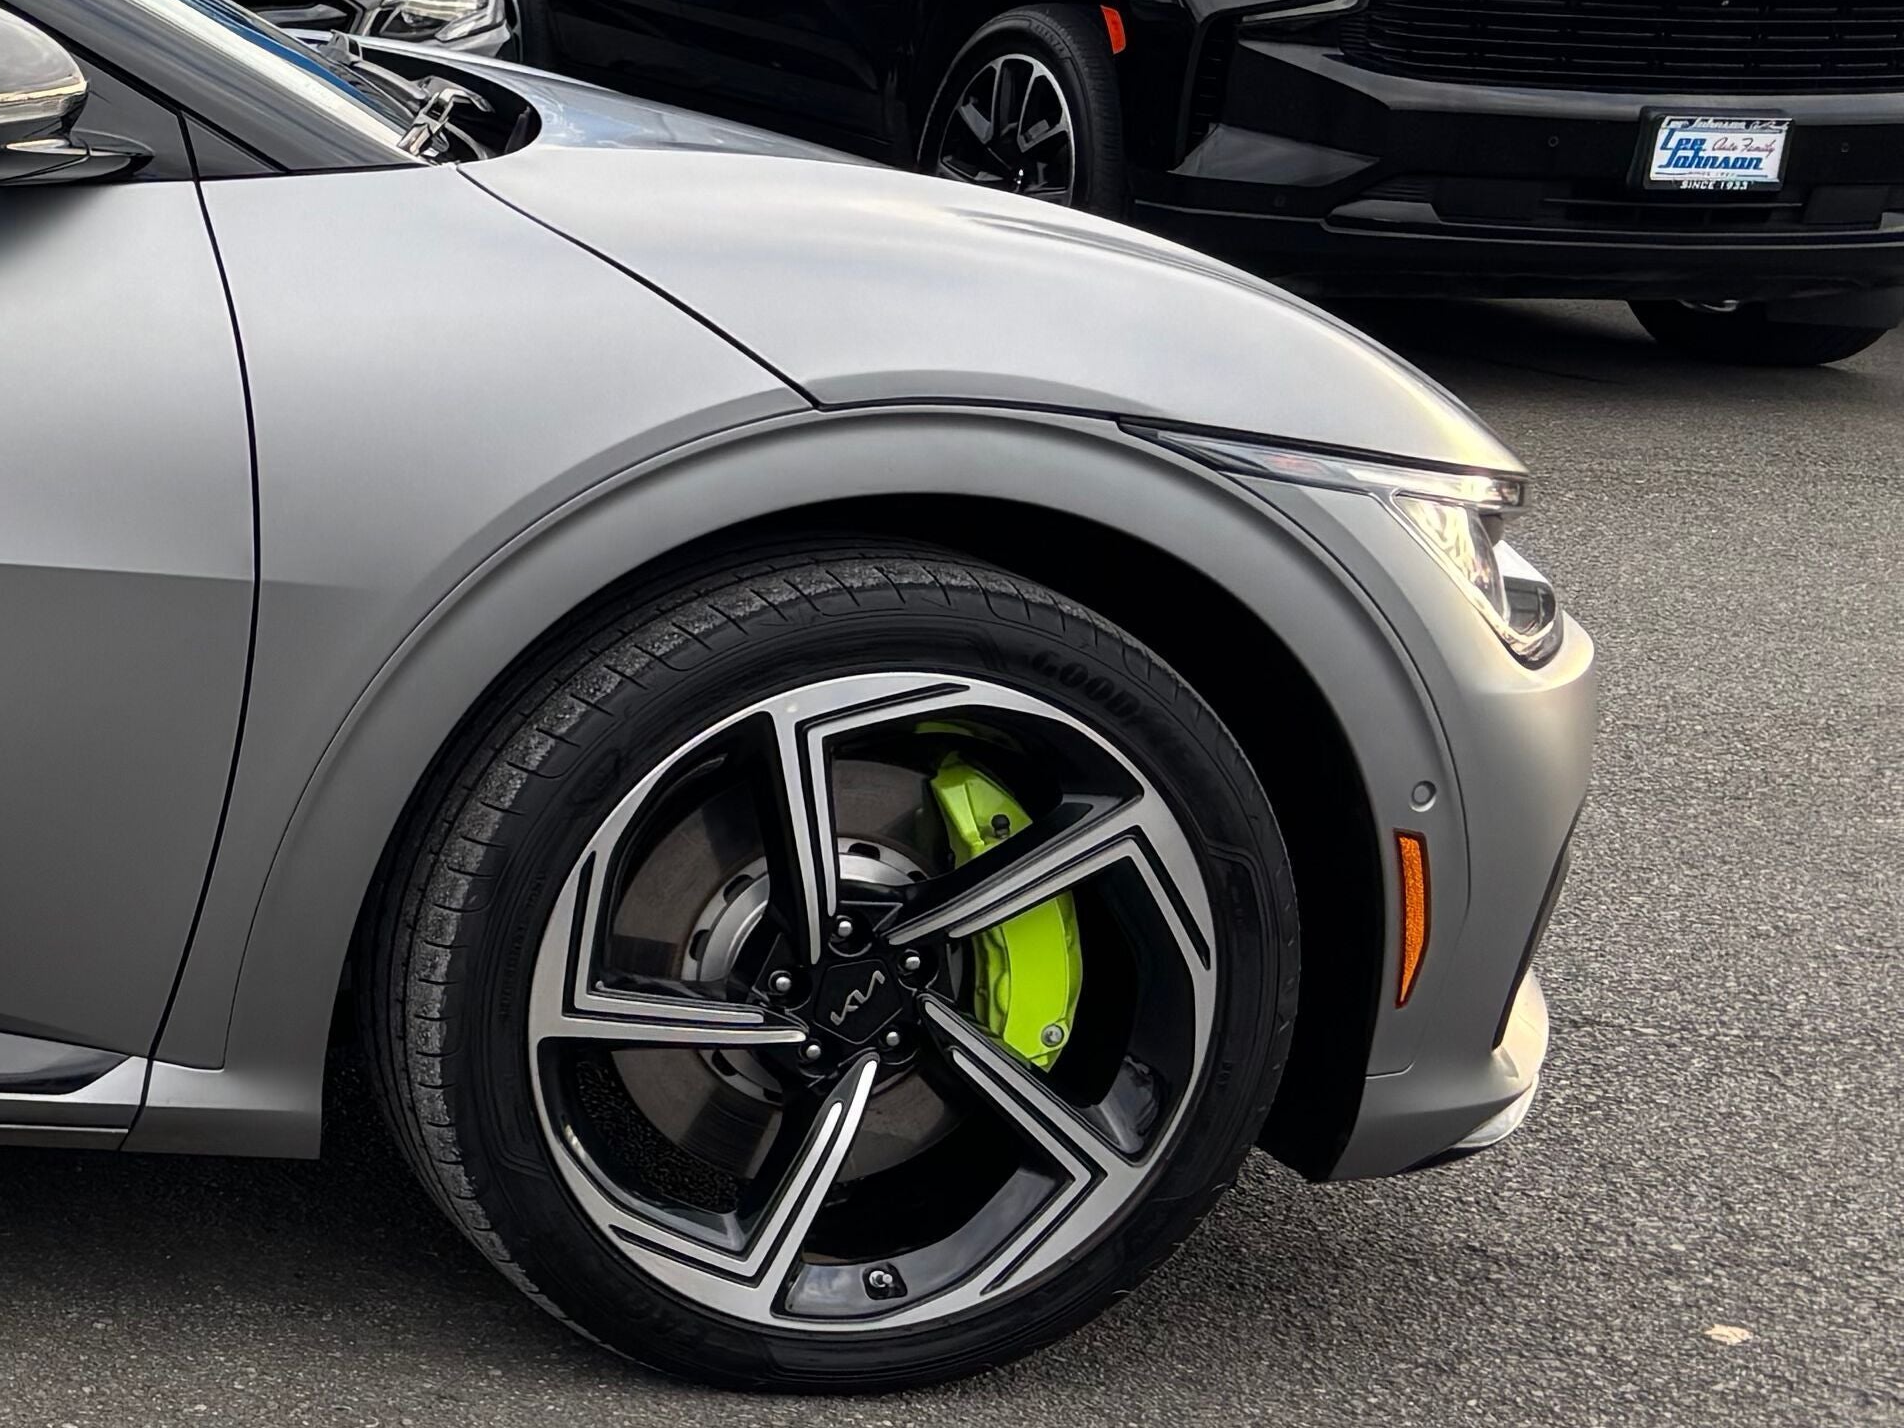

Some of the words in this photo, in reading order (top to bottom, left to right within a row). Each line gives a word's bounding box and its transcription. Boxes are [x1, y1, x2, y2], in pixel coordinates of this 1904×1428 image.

[1660, 128, 1707, 152] Lee
[1658, 147, 1764, 170] Johnson
[1679, 179, 1716, 190] SINCE
[1720, 180, 1748, 191] 1933
